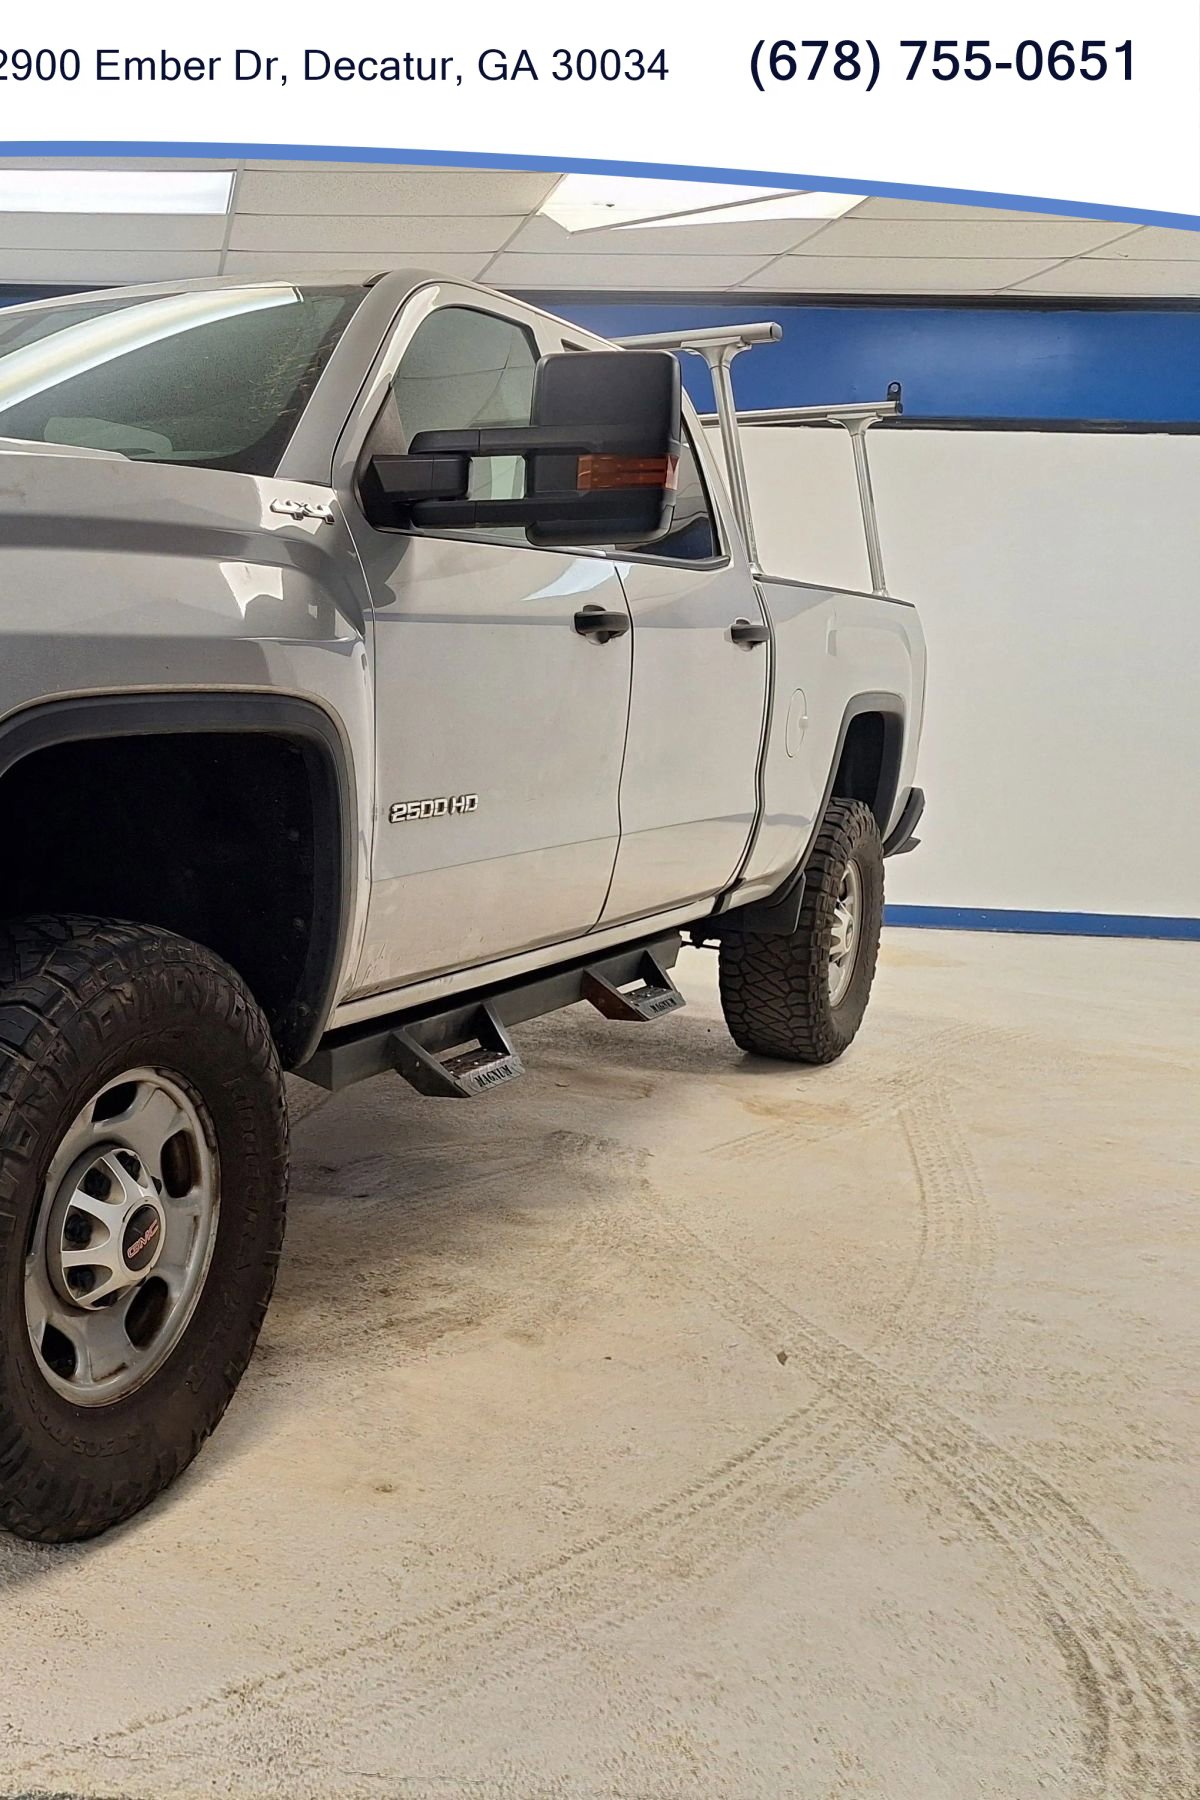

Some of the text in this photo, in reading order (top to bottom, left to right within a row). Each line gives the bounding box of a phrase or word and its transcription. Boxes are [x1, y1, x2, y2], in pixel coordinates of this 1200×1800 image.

[389, 793, 479, 823] 2500 HD
[474, 1064, 513, 1088] MAGNUM
[126, 1219, 159, 1258] GMC
